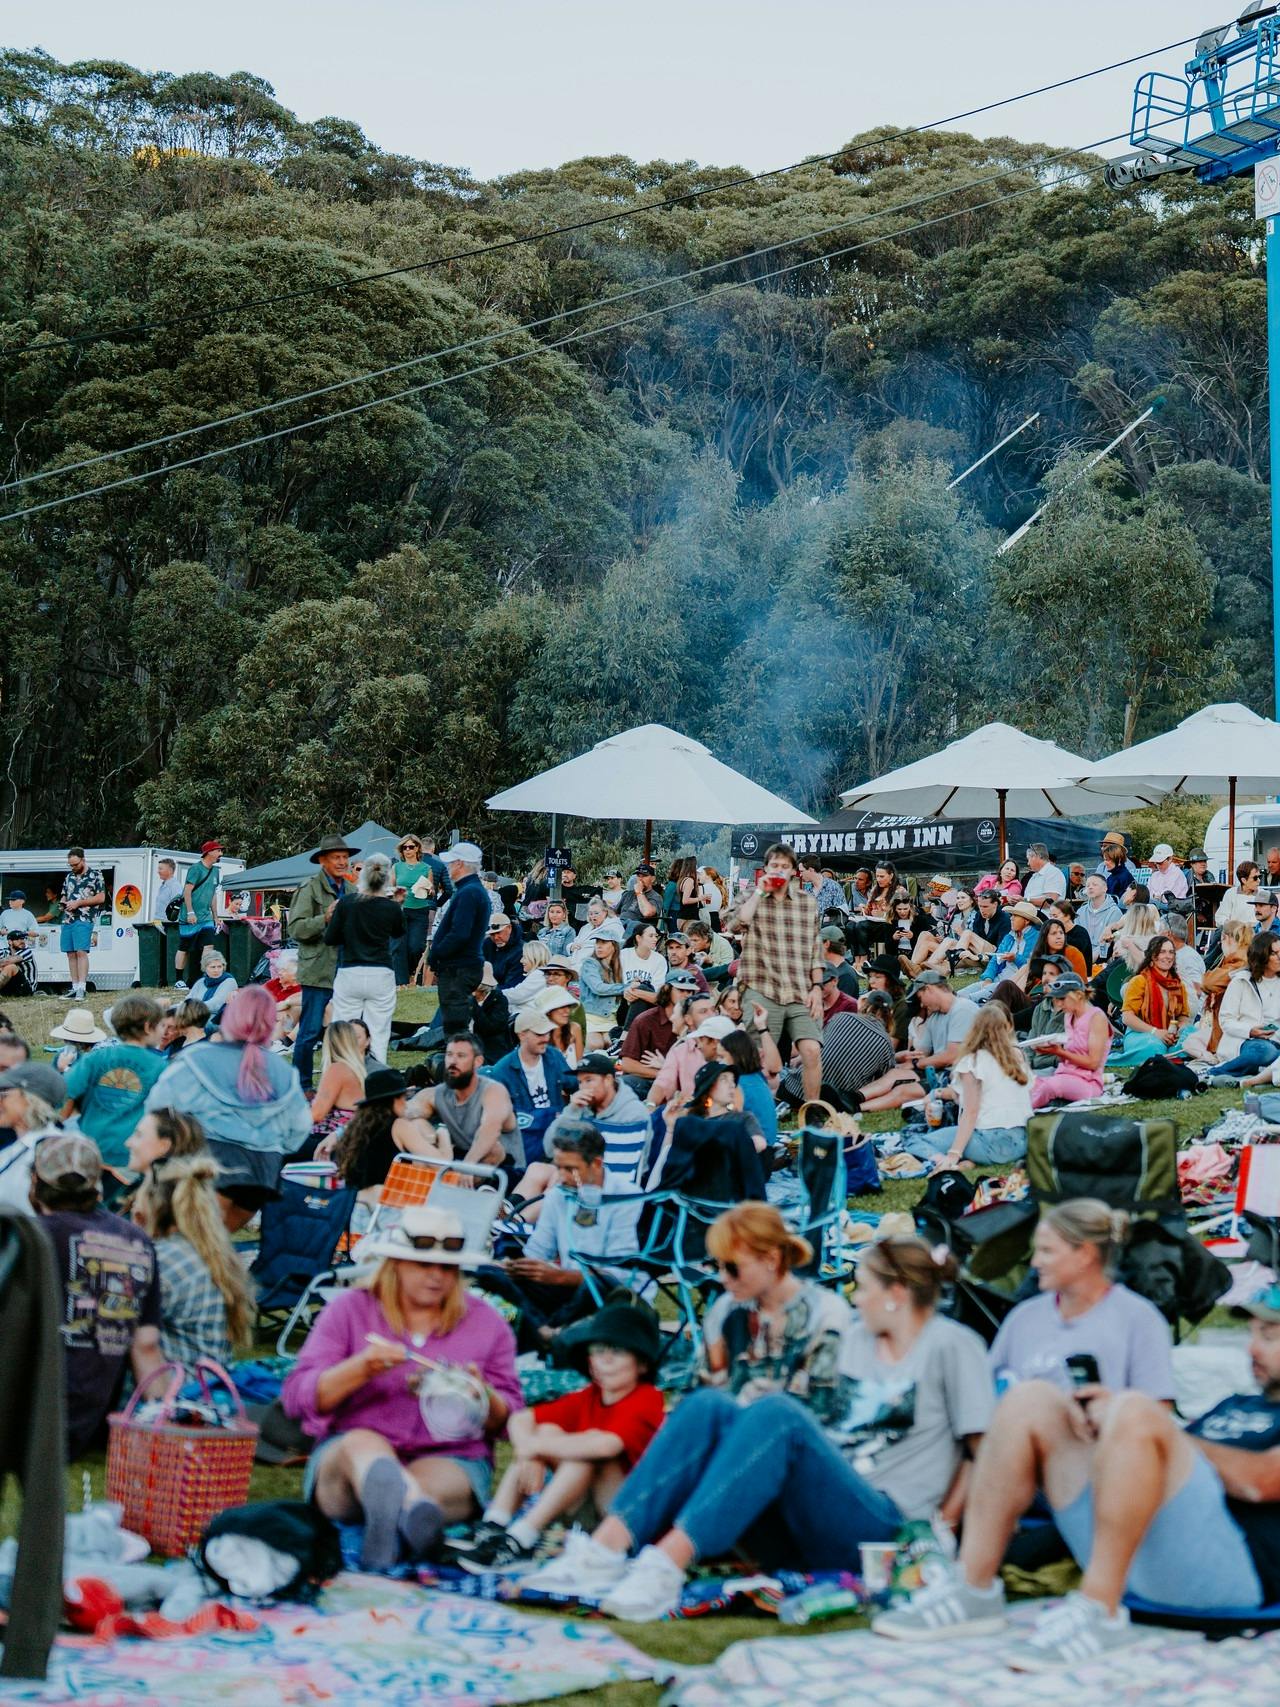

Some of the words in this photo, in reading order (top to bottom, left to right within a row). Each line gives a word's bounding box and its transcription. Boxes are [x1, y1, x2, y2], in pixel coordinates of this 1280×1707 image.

[781, 832, 857, 853] FRYING
[863, 829, 906, 851] PAN
[913, 825, 954, 847] INN
[548, 857, 568, 865] TOILETS
